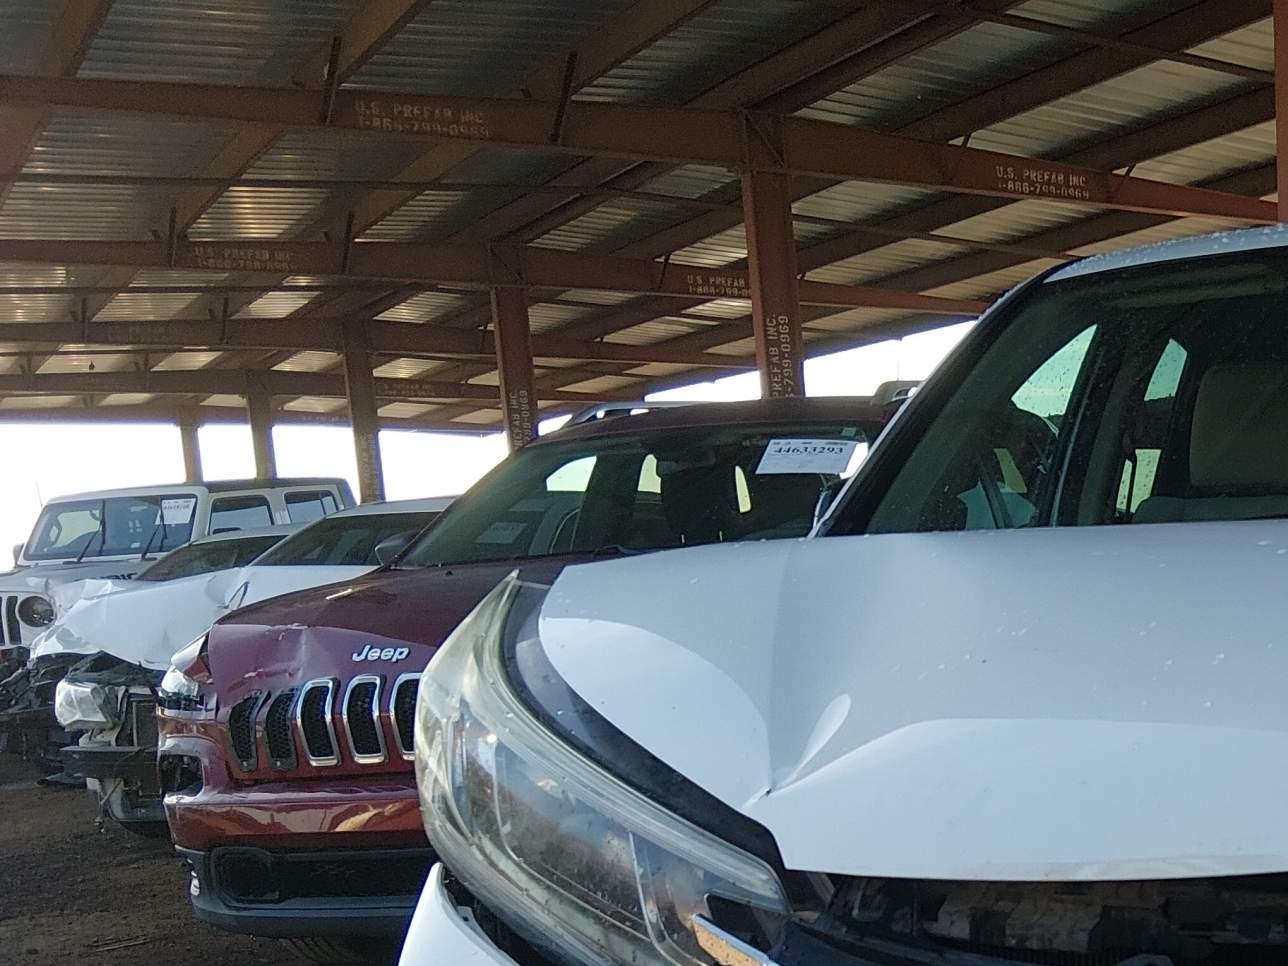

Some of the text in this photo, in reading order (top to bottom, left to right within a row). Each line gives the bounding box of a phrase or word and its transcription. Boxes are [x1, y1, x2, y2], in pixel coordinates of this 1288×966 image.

[1023, 168, 1065, 185] PREFAB
[766, 313, 779, 340] INC.
[352, 644, 409, 662] Jeep
